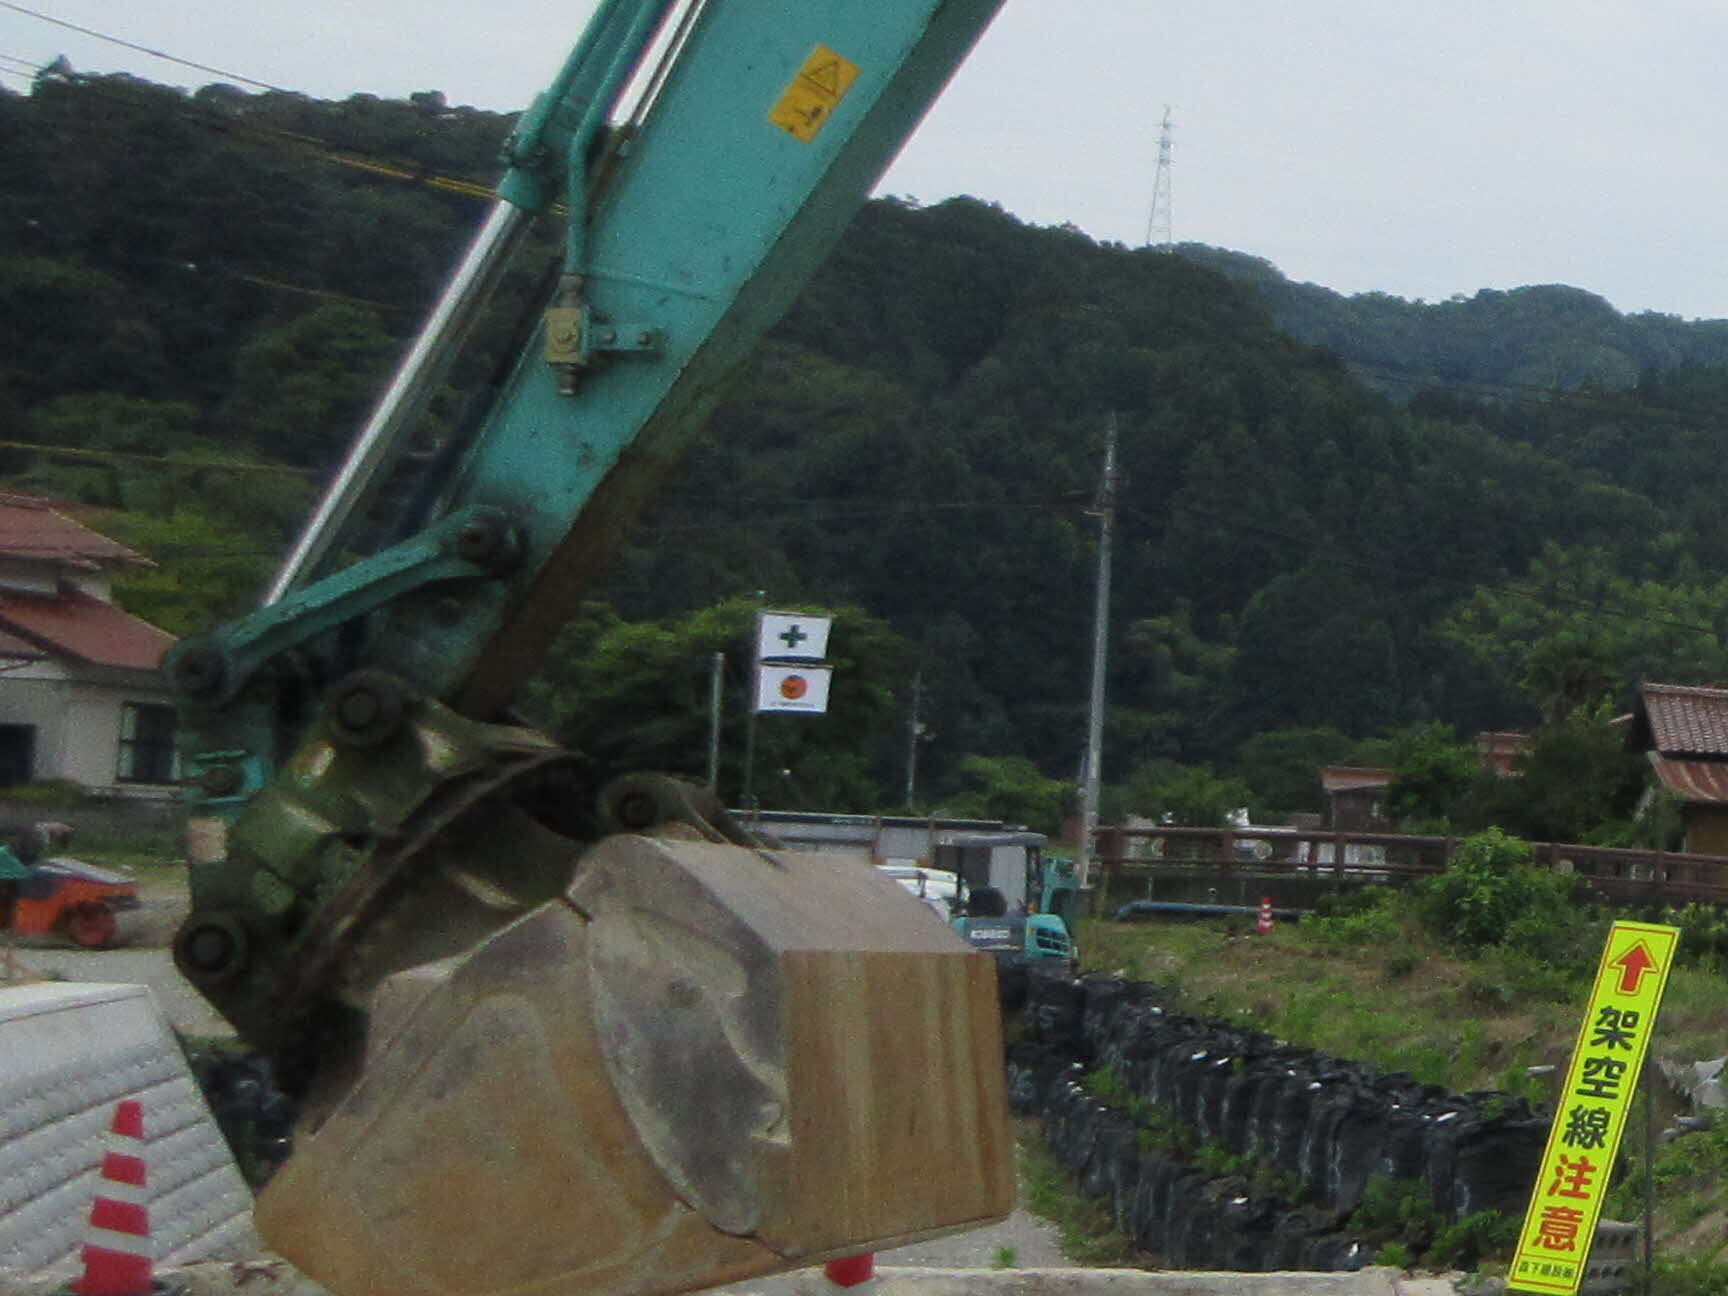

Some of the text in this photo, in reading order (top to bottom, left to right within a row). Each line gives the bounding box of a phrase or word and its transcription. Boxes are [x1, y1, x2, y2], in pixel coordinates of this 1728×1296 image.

[1531, 1004, 1640, 1252] 架空線注意
